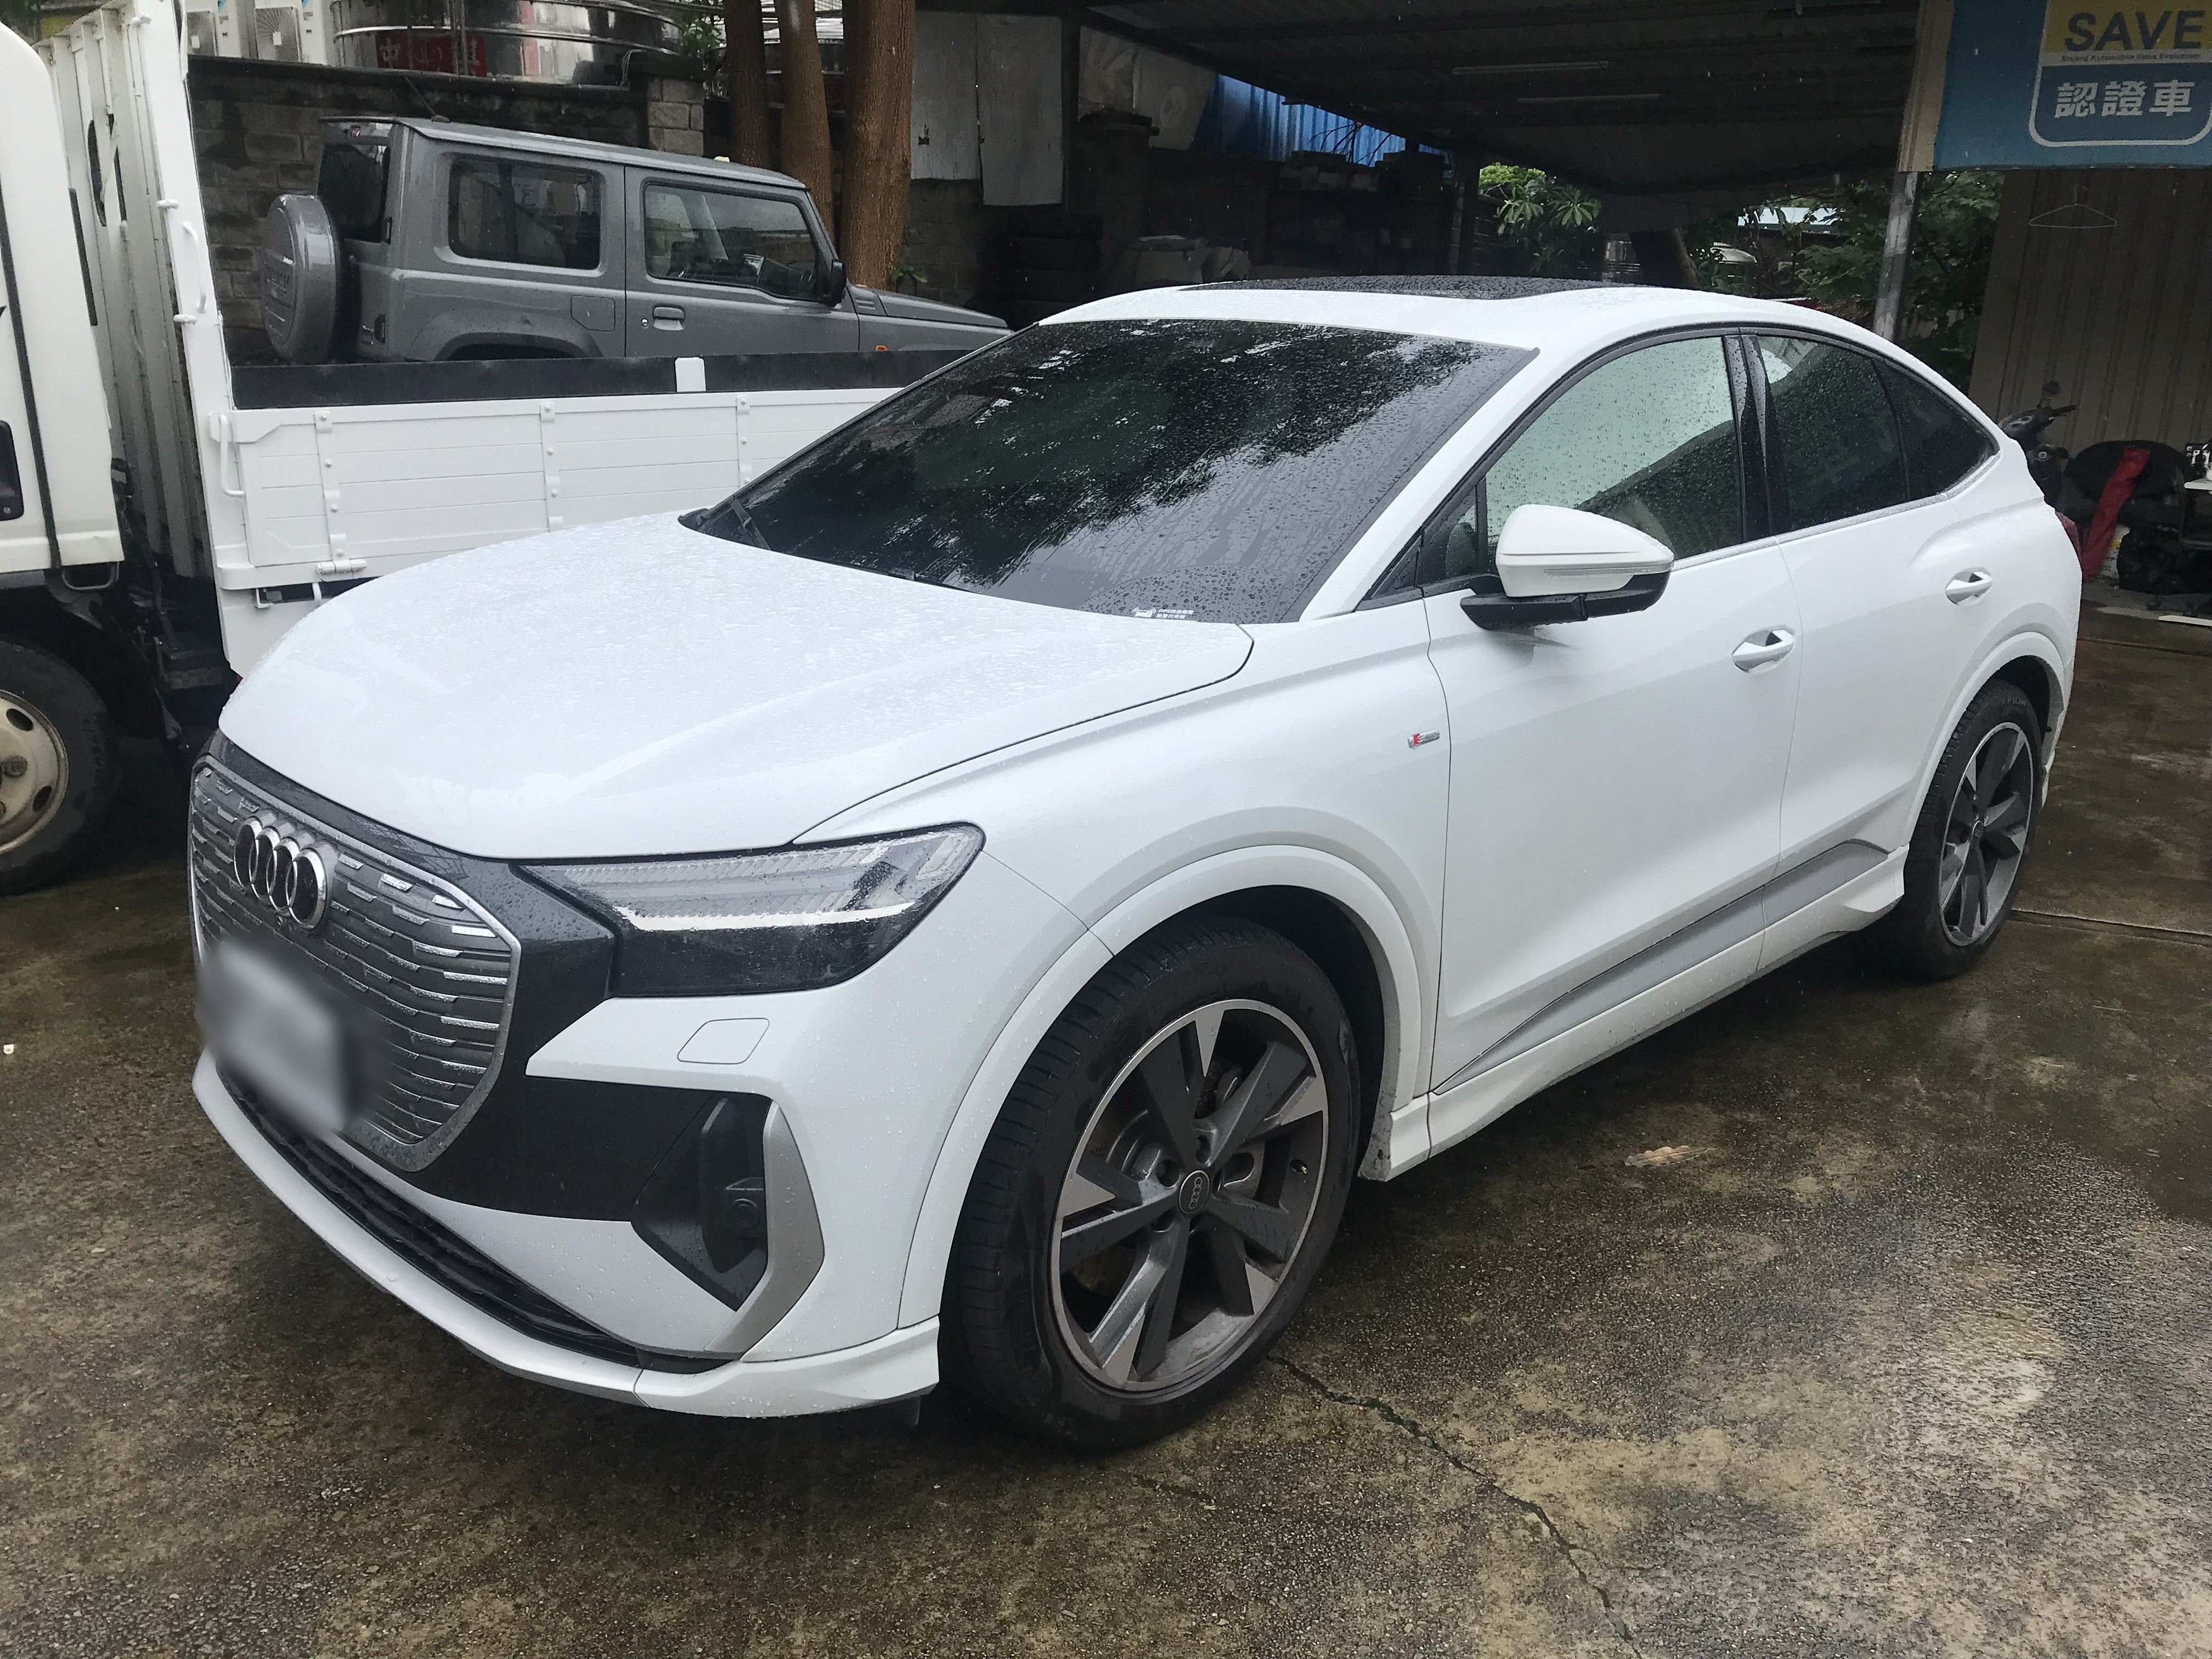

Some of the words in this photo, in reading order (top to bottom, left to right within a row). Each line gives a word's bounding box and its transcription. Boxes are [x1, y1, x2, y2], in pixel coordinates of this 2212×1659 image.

[2065, 10, 2205, 51] SAVE
[2055, 80, 2195, 118] 認證車
